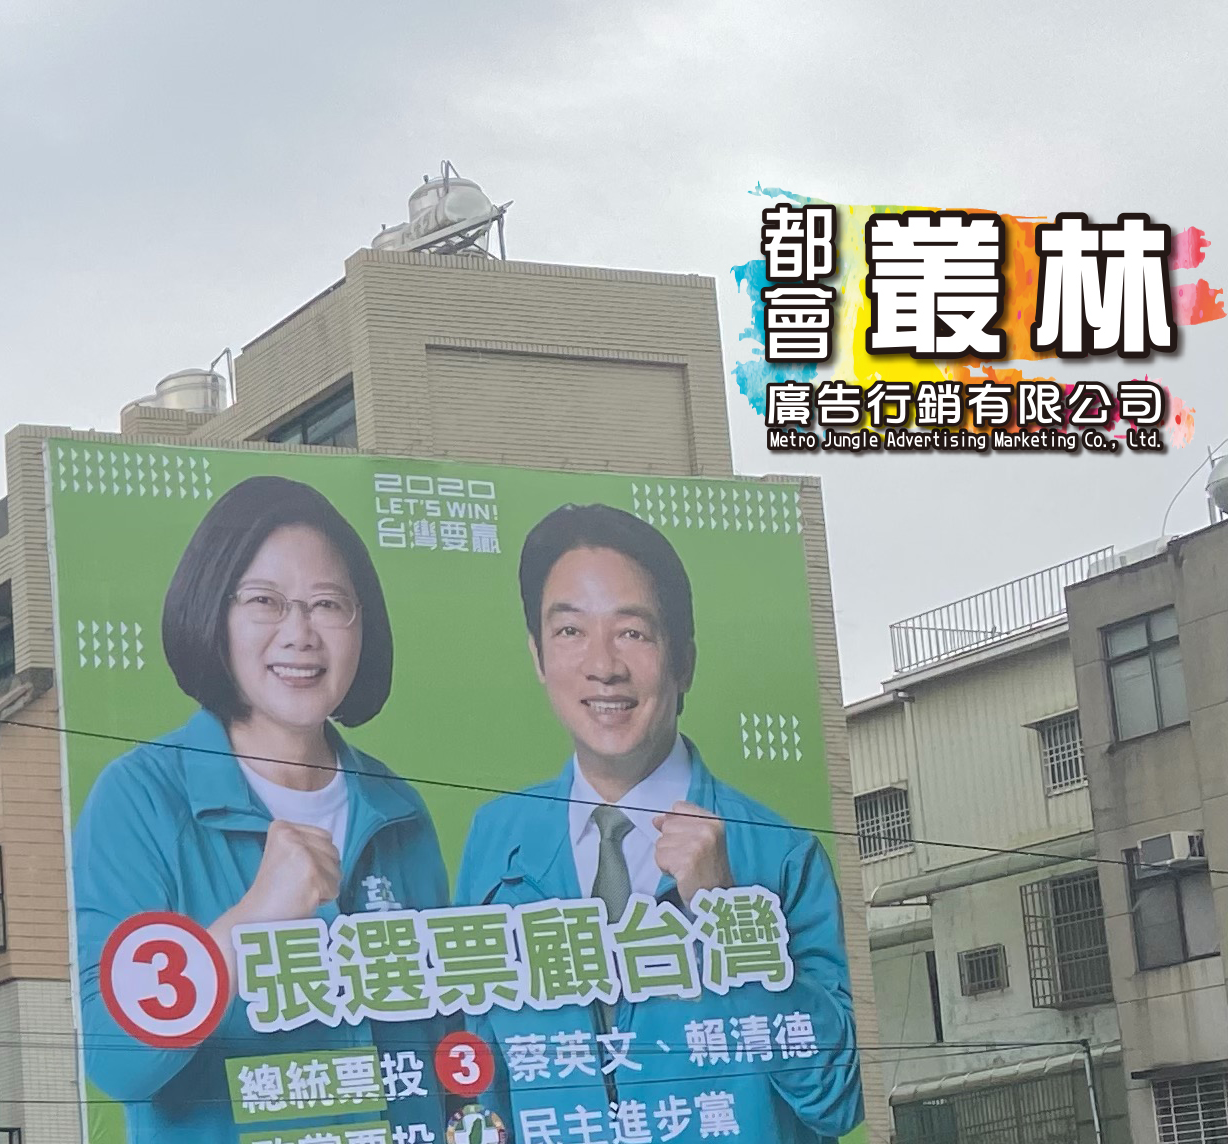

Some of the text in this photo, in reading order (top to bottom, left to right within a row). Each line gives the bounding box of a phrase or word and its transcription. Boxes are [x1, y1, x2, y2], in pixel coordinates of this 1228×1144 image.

[374, 473, 496, 499] 2020
[376, 497, 499, 521] LET'S WIN!
[377, 517, 502, 553] 台灣要贏
[130, 891, 789, 1027] 3 張選票顧台灣
[238, 1011, 821, 1113] 總統票投 3 蔡英文、賴清德
